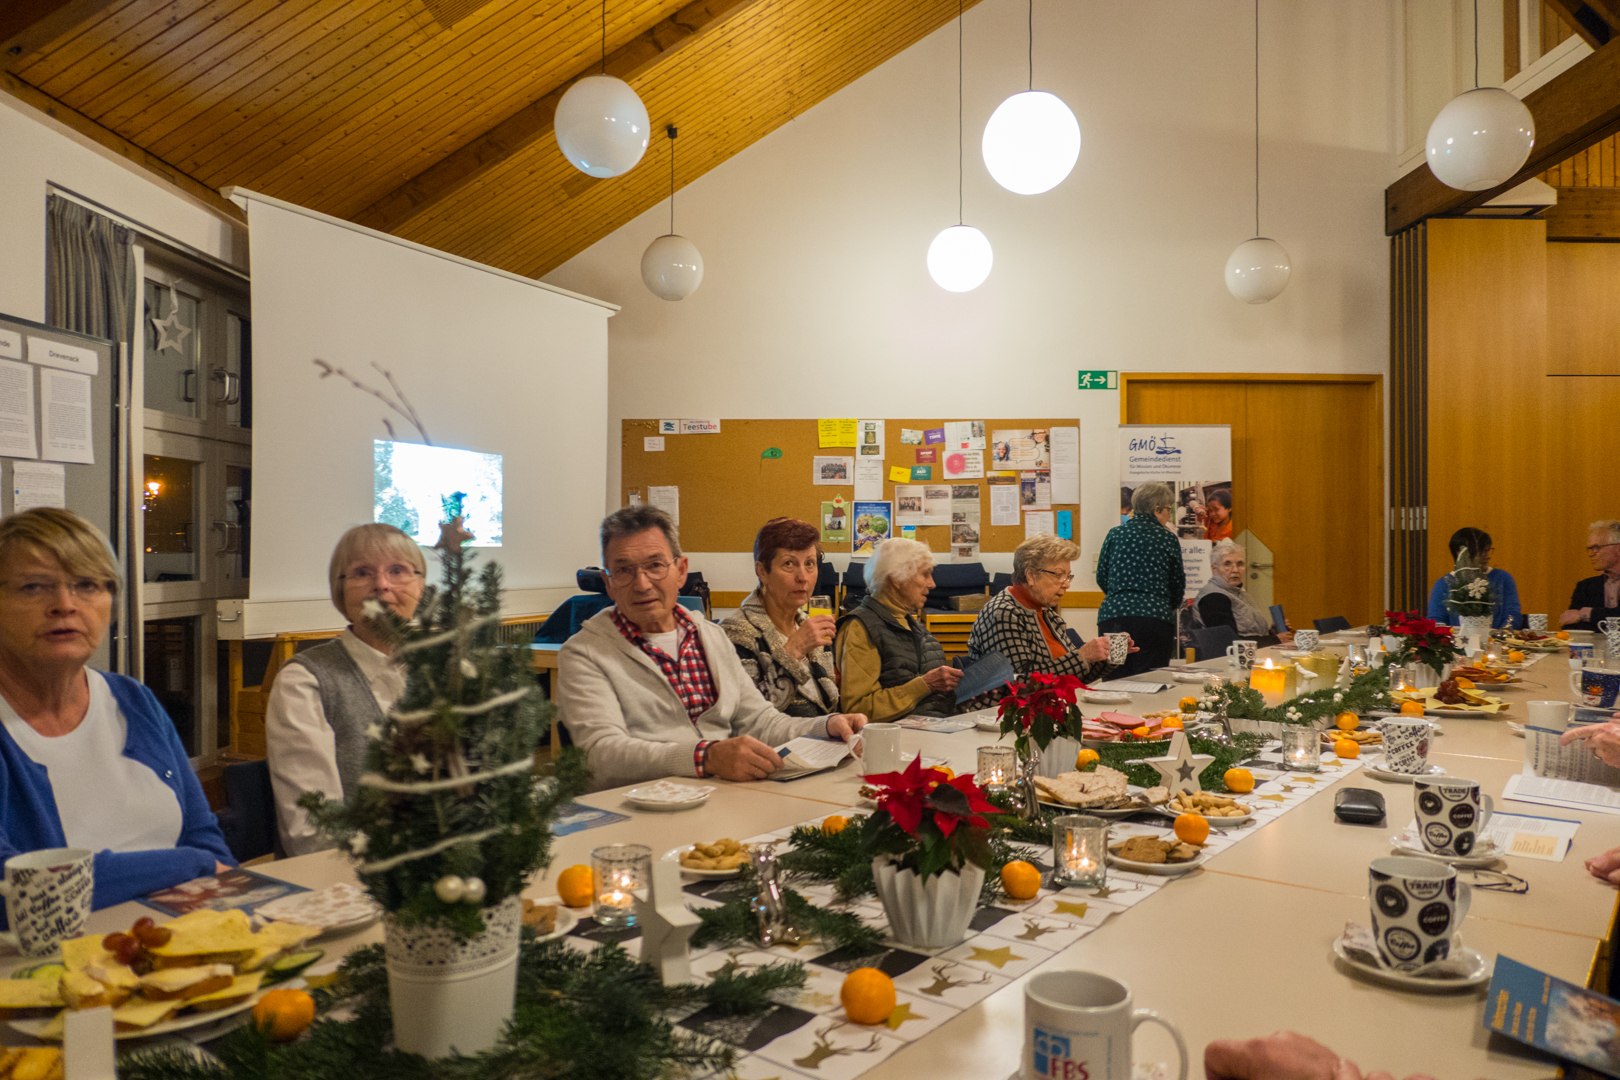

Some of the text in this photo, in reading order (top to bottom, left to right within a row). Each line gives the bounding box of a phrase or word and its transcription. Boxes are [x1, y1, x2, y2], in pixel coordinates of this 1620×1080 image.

[49, 350, 80, 362] Drevenack
[1129, 435, 1156, 451] GMÖ
[1189, 546, 1206, 554] alle:
[1391, 740, 1415, 755] COFFEE
[1409, 881, 1441, 890] TRADE
[1422, 914, 1448, 924] COFFEE
